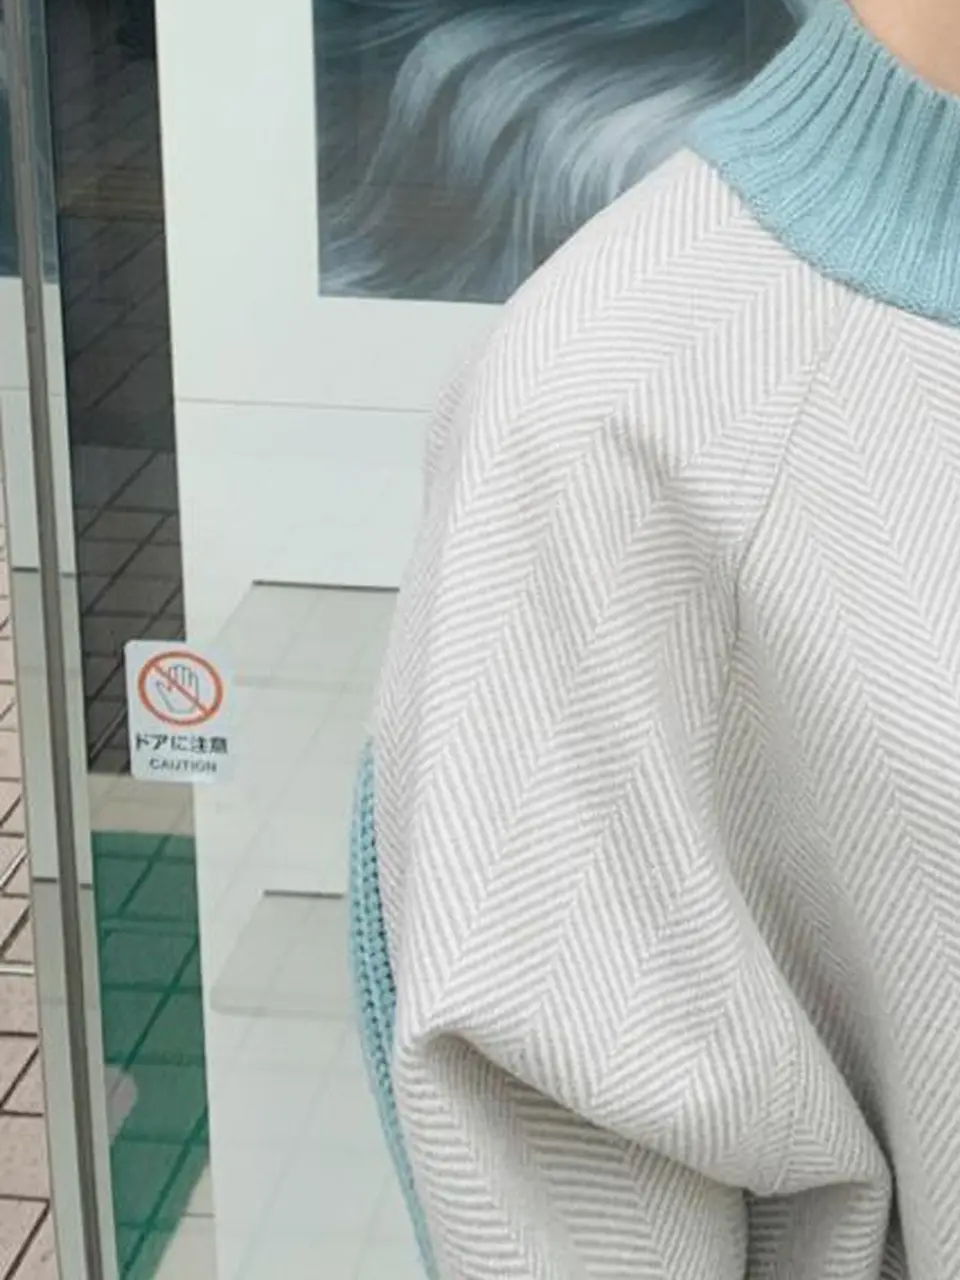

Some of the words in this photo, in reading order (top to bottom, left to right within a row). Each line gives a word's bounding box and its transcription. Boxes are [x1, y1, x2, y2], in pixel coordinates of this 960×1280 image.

[135, 732, 228, 754] ドアに注意
[149, 758, 217, 772] CAUTION
